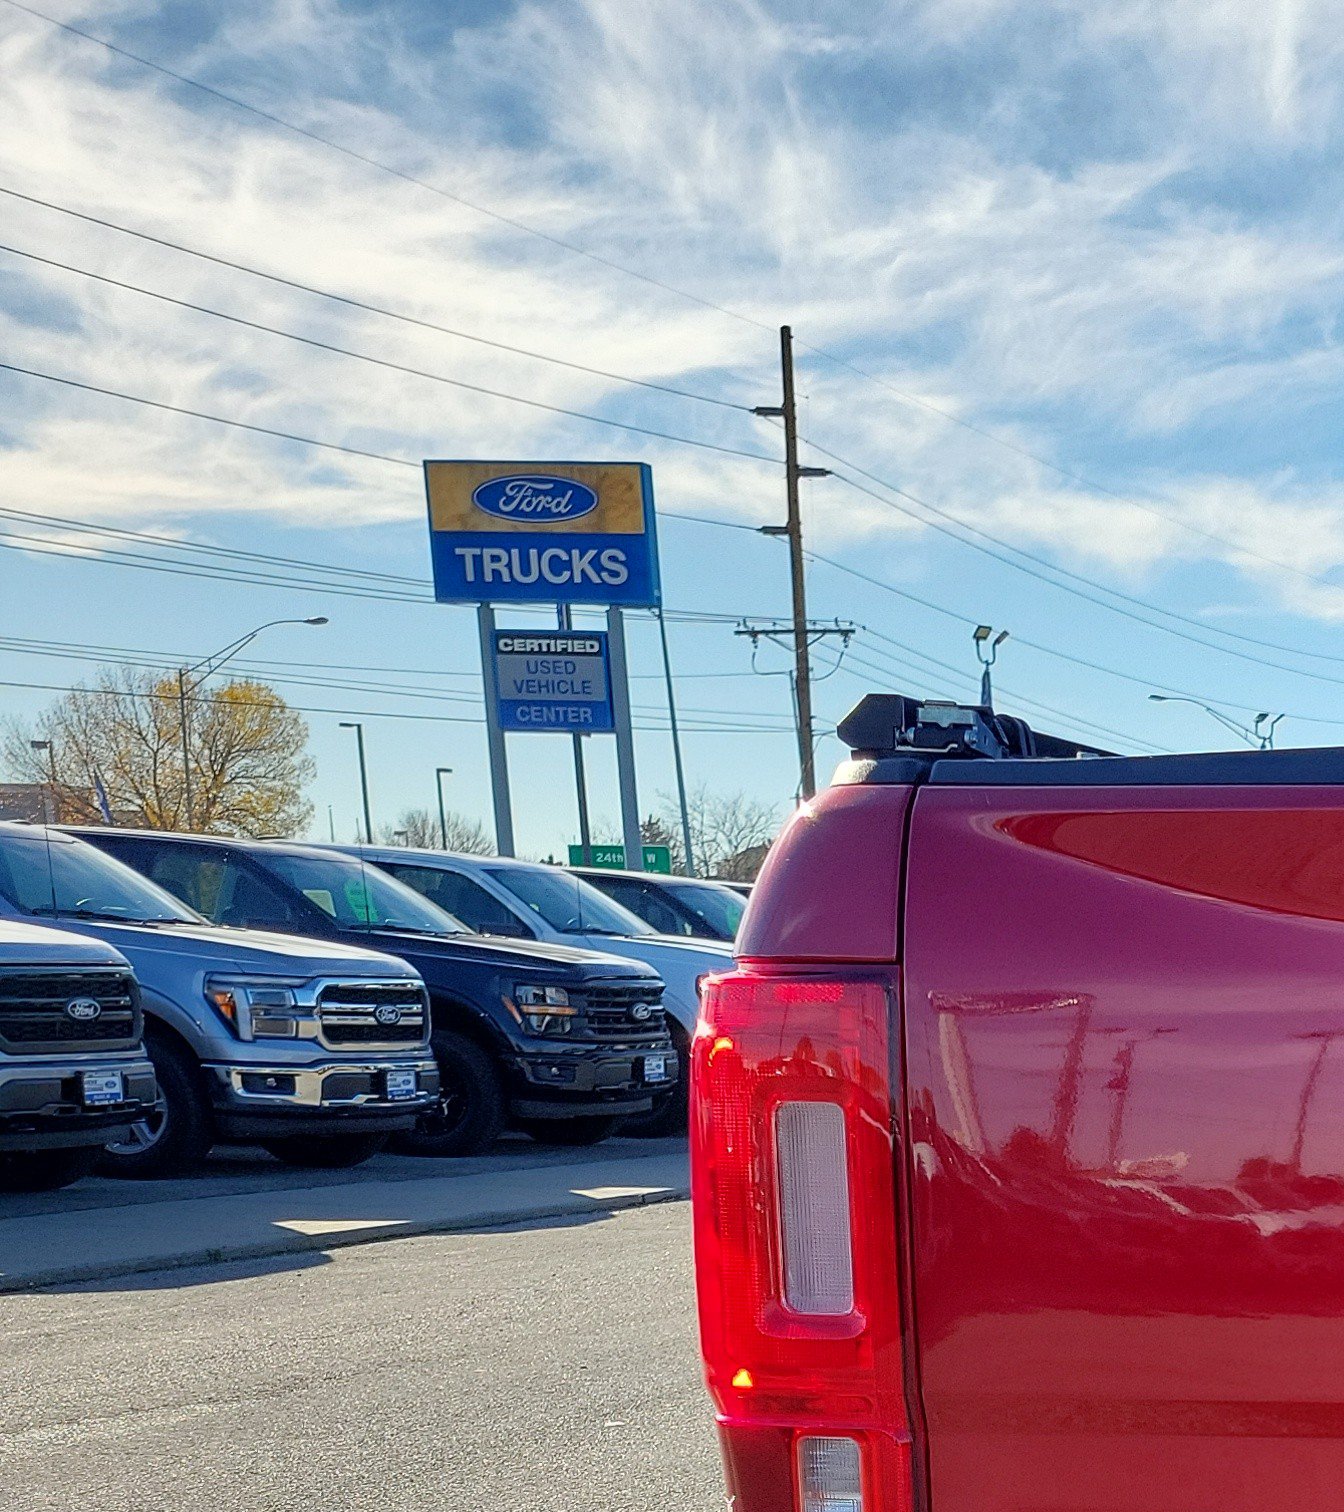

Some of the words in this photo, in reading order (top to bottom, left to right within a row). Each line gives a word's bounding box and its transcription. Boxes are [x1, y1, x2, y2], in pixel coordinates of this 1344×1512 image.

[499, 479, 574, 515] Ford
[454, 547, 629, 586] TRUCKS
[498, 637, 600, 654] CERTIFIED
[526, 659, 577, 676] USED
[513, 678, 593, 696] VEHICLE
[516, 705, 593, 724] CENTER
